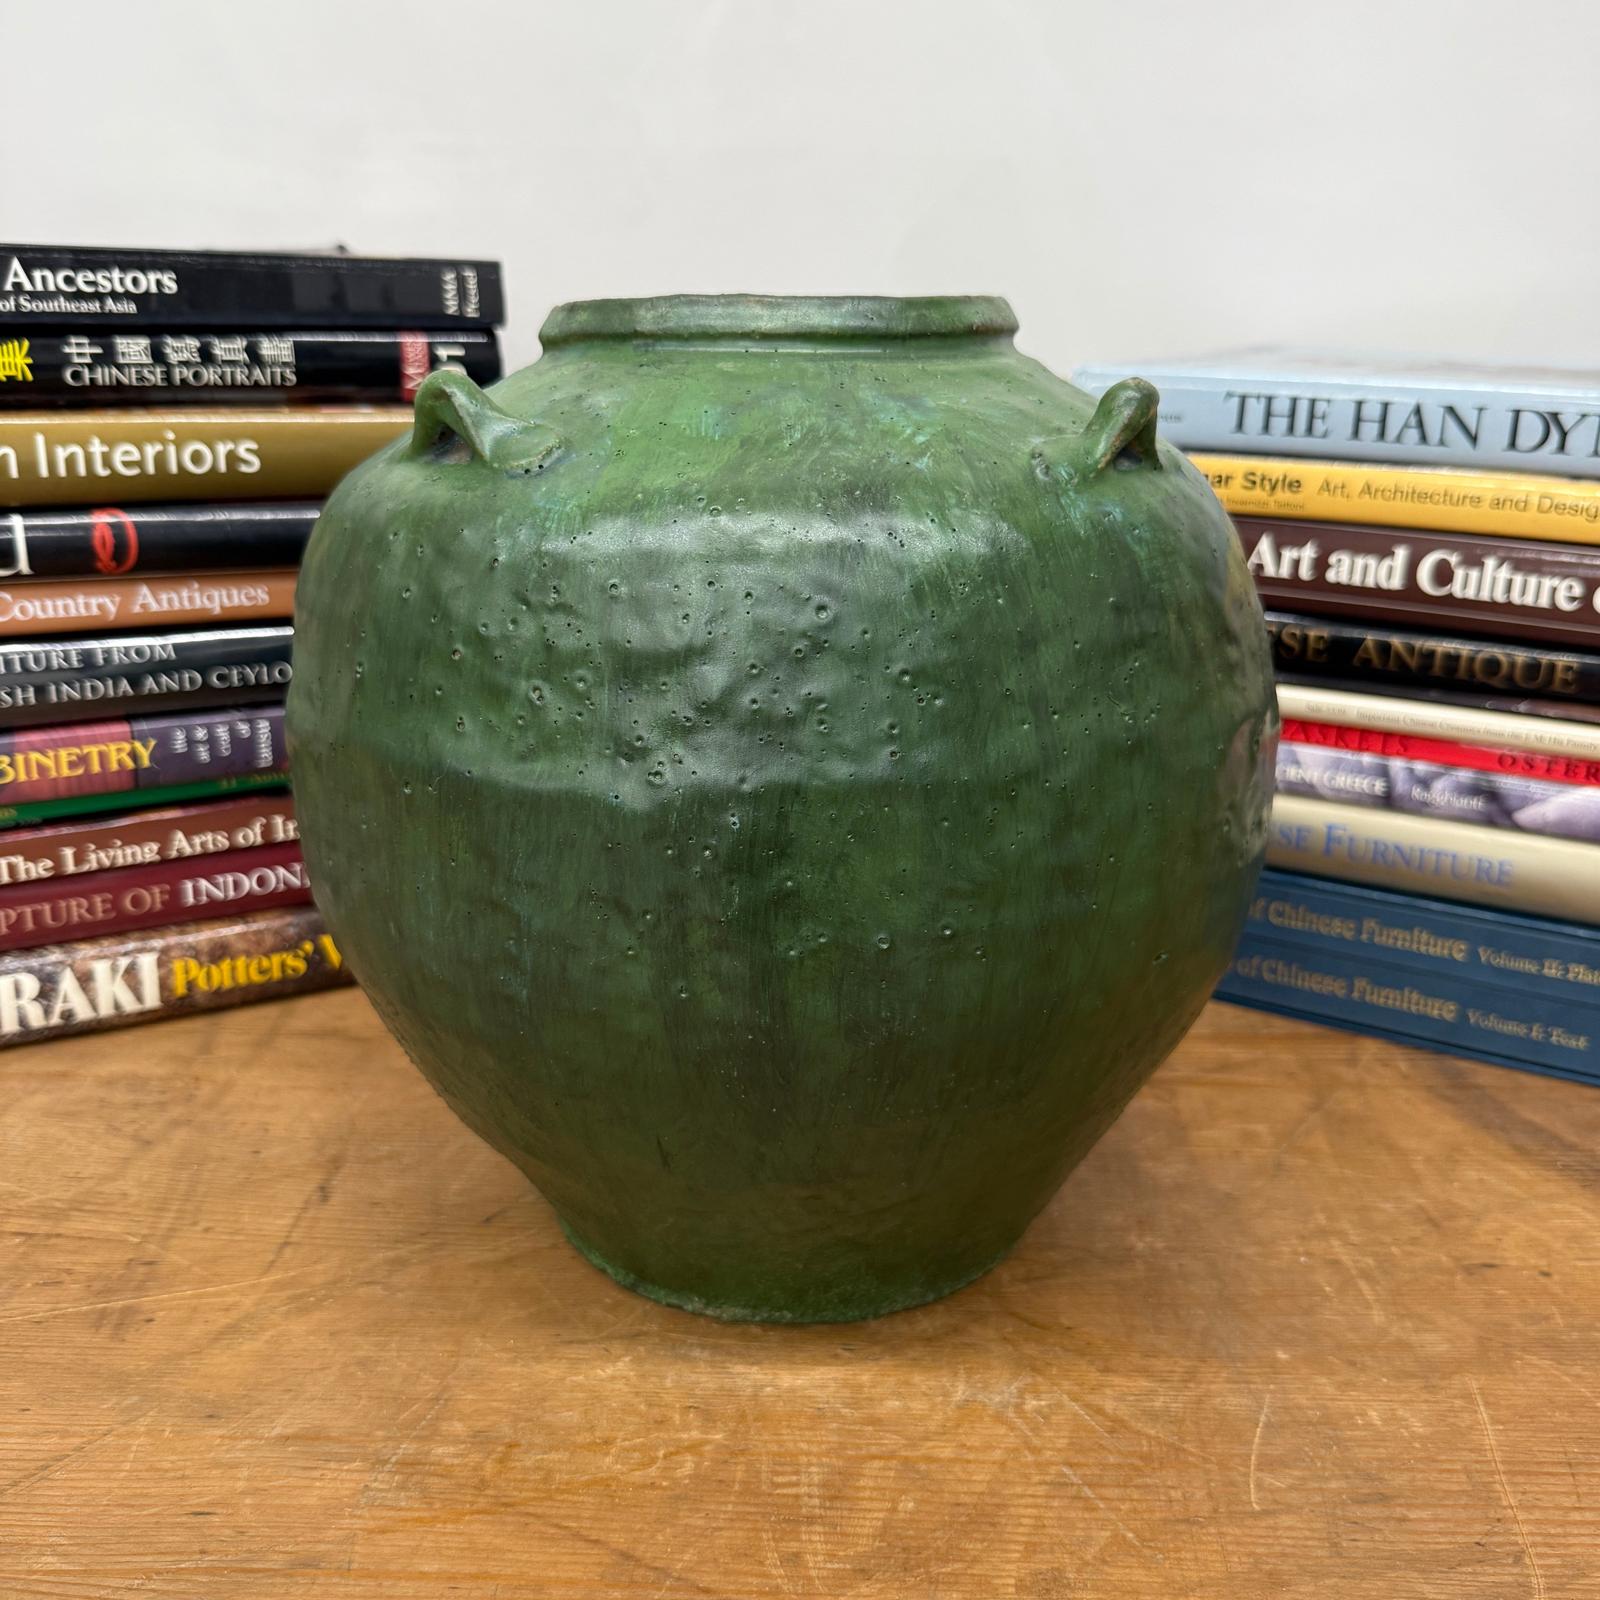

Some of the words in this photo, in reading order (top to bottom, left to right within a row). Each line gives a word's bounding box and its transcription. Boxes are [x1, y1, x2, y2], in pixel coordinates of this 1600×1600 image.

[3, 256, 178, 294] Ancestors
[0, 294, 15, 312] of
[18, 295, 101, 313] Southeast
[104, 297, 138, 314] Asia
[63, 364, 168, 388] CHINESE
[171, 364, 298, 388] PORTRAITS
[1224, 390, 1333, 440] THE
[1346, 399, 1490, 451] HAN
[35, 430, 262, 478] Interiors
[1202, 471, 1233, 490] ar
[1242, 470, 1303, 497] Style
[1316, 478, 1350, 500] Art,
[1358, 480, 1483, 510] Architecture
[1488, 490, 1528, 514] and
[1247, 531, 1321, 581] Art
[1325, 543, 1409, 591] and
[1416, 549, 1586, 612] Culture
[0, 590, 122, 622] Country
[130, 582, 271, 615] Antiques
[95, 643, 178, 667] FROM
[1266, 620, 1331, 663] SE
[1352, 630, 1581, 695] ANTIQUE
[47, 675, 135, 705] INDIA
[140, 669, 203, 695] AND
[206, 661, 293, 689] CEYLO
[0, 737, 158, 785] BINETRY
[0, 851, 55, 886] The
[59, 838, 161, 876] Living
[167, 828, 230, 860] Arts
[232, 815, 267, 850] of
[1324, 822, 1514, 888] FURNITURE
[0, 890, 117, 936] PTURE
[122, 883, 171, 916] OF
[1268, 900, 1357, 942] Chinese
[1361, 916, 1470, 963] Furniture
[1477, 945, 1541, 974] Volume
[0, 951, 164, 1035] RAKI
[171, 939, 315, 999] Potters'
[1262, 957, 1348, 999] Chinese
[1351, 975, 1460, 1023] Furniture
[1467, 1007, 1529, 1039] Volume
[1547, 1025, 1591, 1052] Text
